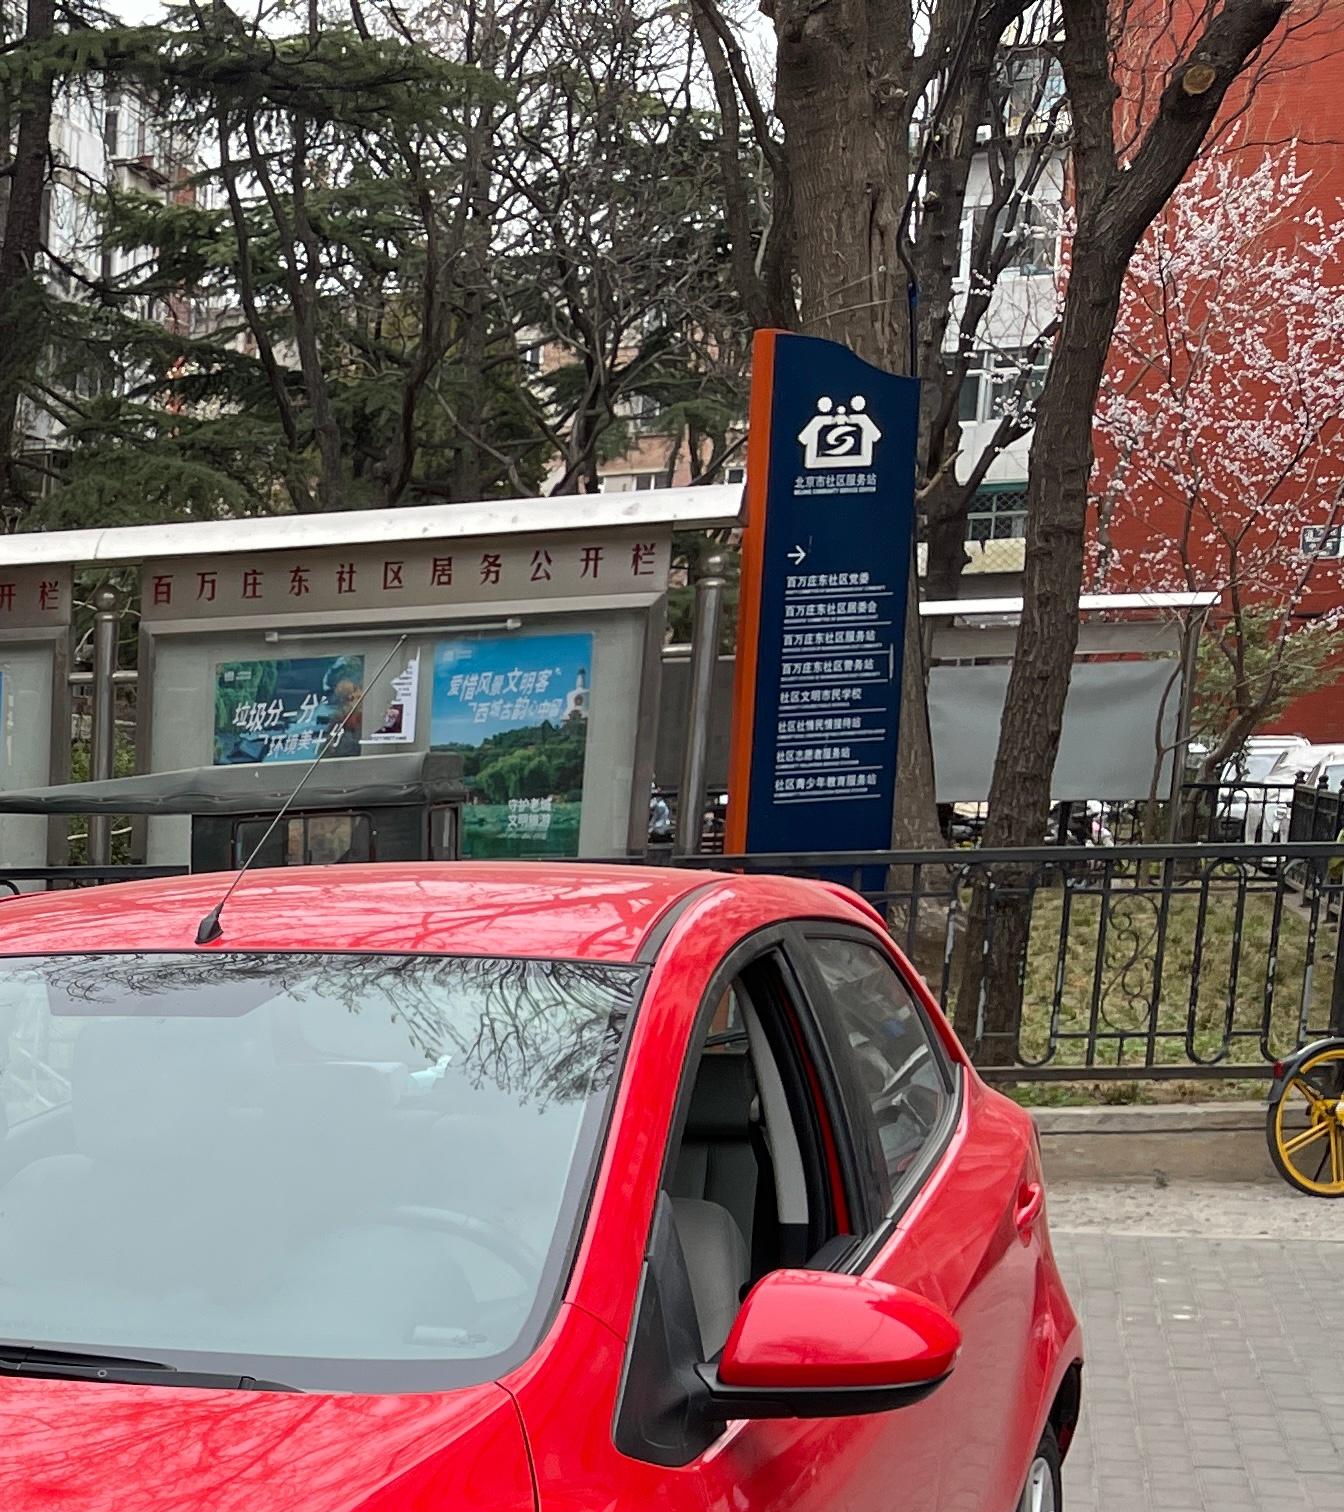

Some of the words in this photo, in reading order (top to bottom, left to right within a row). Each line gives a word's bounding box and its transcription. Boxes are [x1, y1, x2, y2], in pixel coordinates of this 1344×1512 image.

[794, 473, 877, 489] 北京市社区服务站
[152, 543, 657, 605] 百万庄东社区居务公开栏
[786, 572, 869, 588] 百万庄东社区党委
[785, 601, 877, 617] 百万庄东社区居委会
[783, 630, 876, 646] 百万庄东社区服务站
[779, 688, 863, 704] 社区文明市民学校
[232, 693, 317, 730] 垃圾分一分
